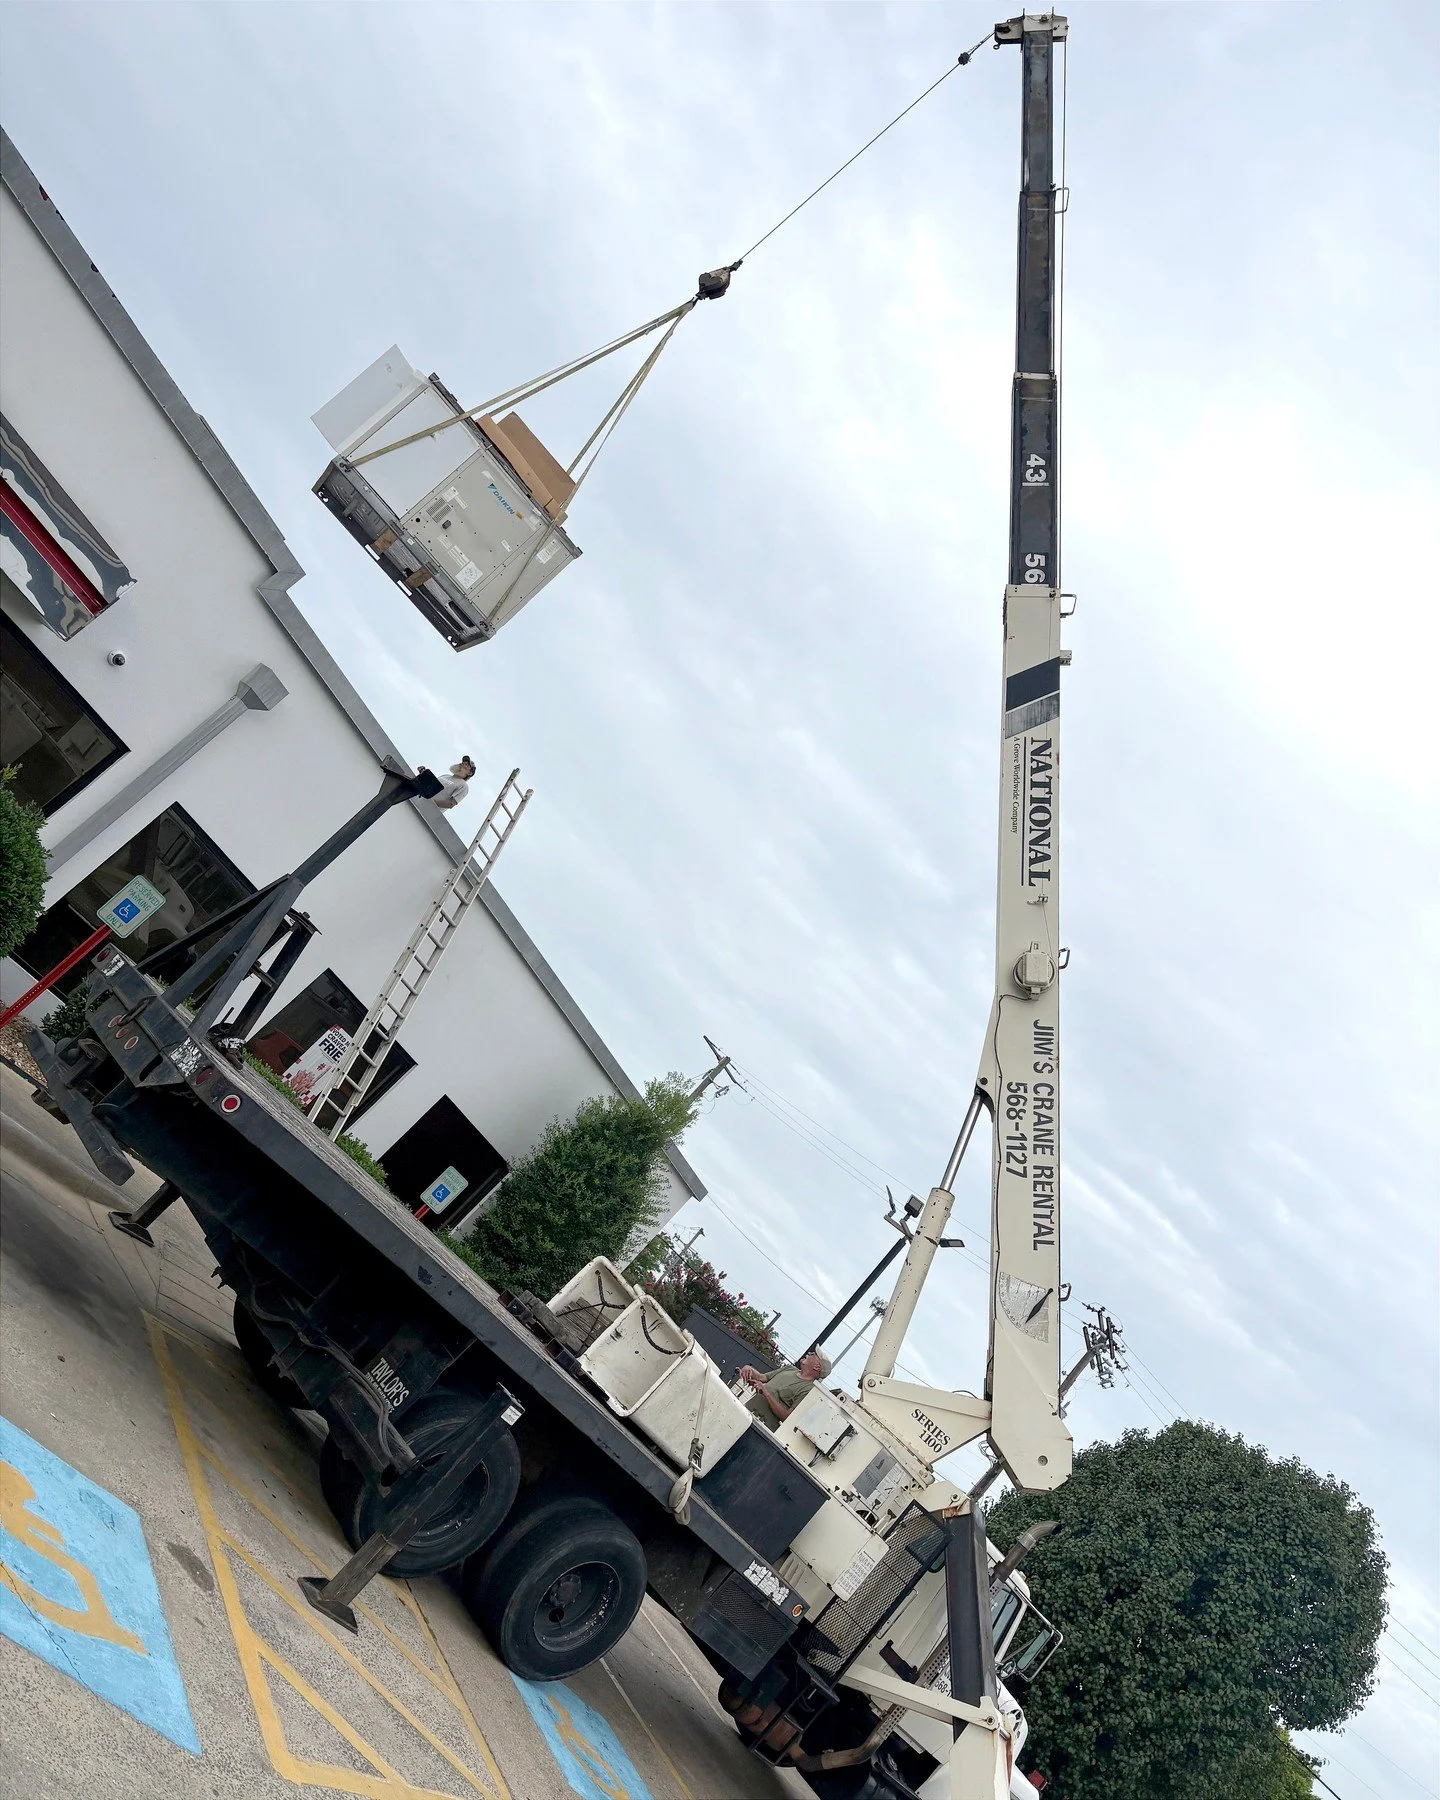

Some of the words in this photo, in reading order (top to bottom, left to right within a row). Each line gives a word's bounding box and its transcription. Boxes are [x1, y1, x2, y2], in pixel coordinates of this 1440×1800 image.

[1025, 453, 1047, 483] 43
[493, 490, 515, 515] DAIKIN
[1024, 552, 1046, 584] 56
[1013, 743, 1021, 763] Grove
[1012, 763, 1021, 801] Worldwide
[1010, 801, 1020, 835] Company
[1028, 737, 1053, 887] NATIONAL
[128, 888, 151, 912] PARKING
[133, 880, 159, 906] RESERVED
[106, 913, 124, 929] ONLY
[318, 1037, 343, 1063] FRIE
[327, 1033, 347, 1053] CRAVEA
[1033, 1018, 1055, 1074] JIM'S
[1005, 1081, 1028, 1179] 568-1127
[1032, 1082, 1055, 1157] CRANE
[1032, 1165, 1055, 1251] RENTAL
[371, 1357, 410, 1407] TAYLOR'S
[911, 1408, 951, 1446] SERIES
[919, 1429, 942, 1453] 1100
